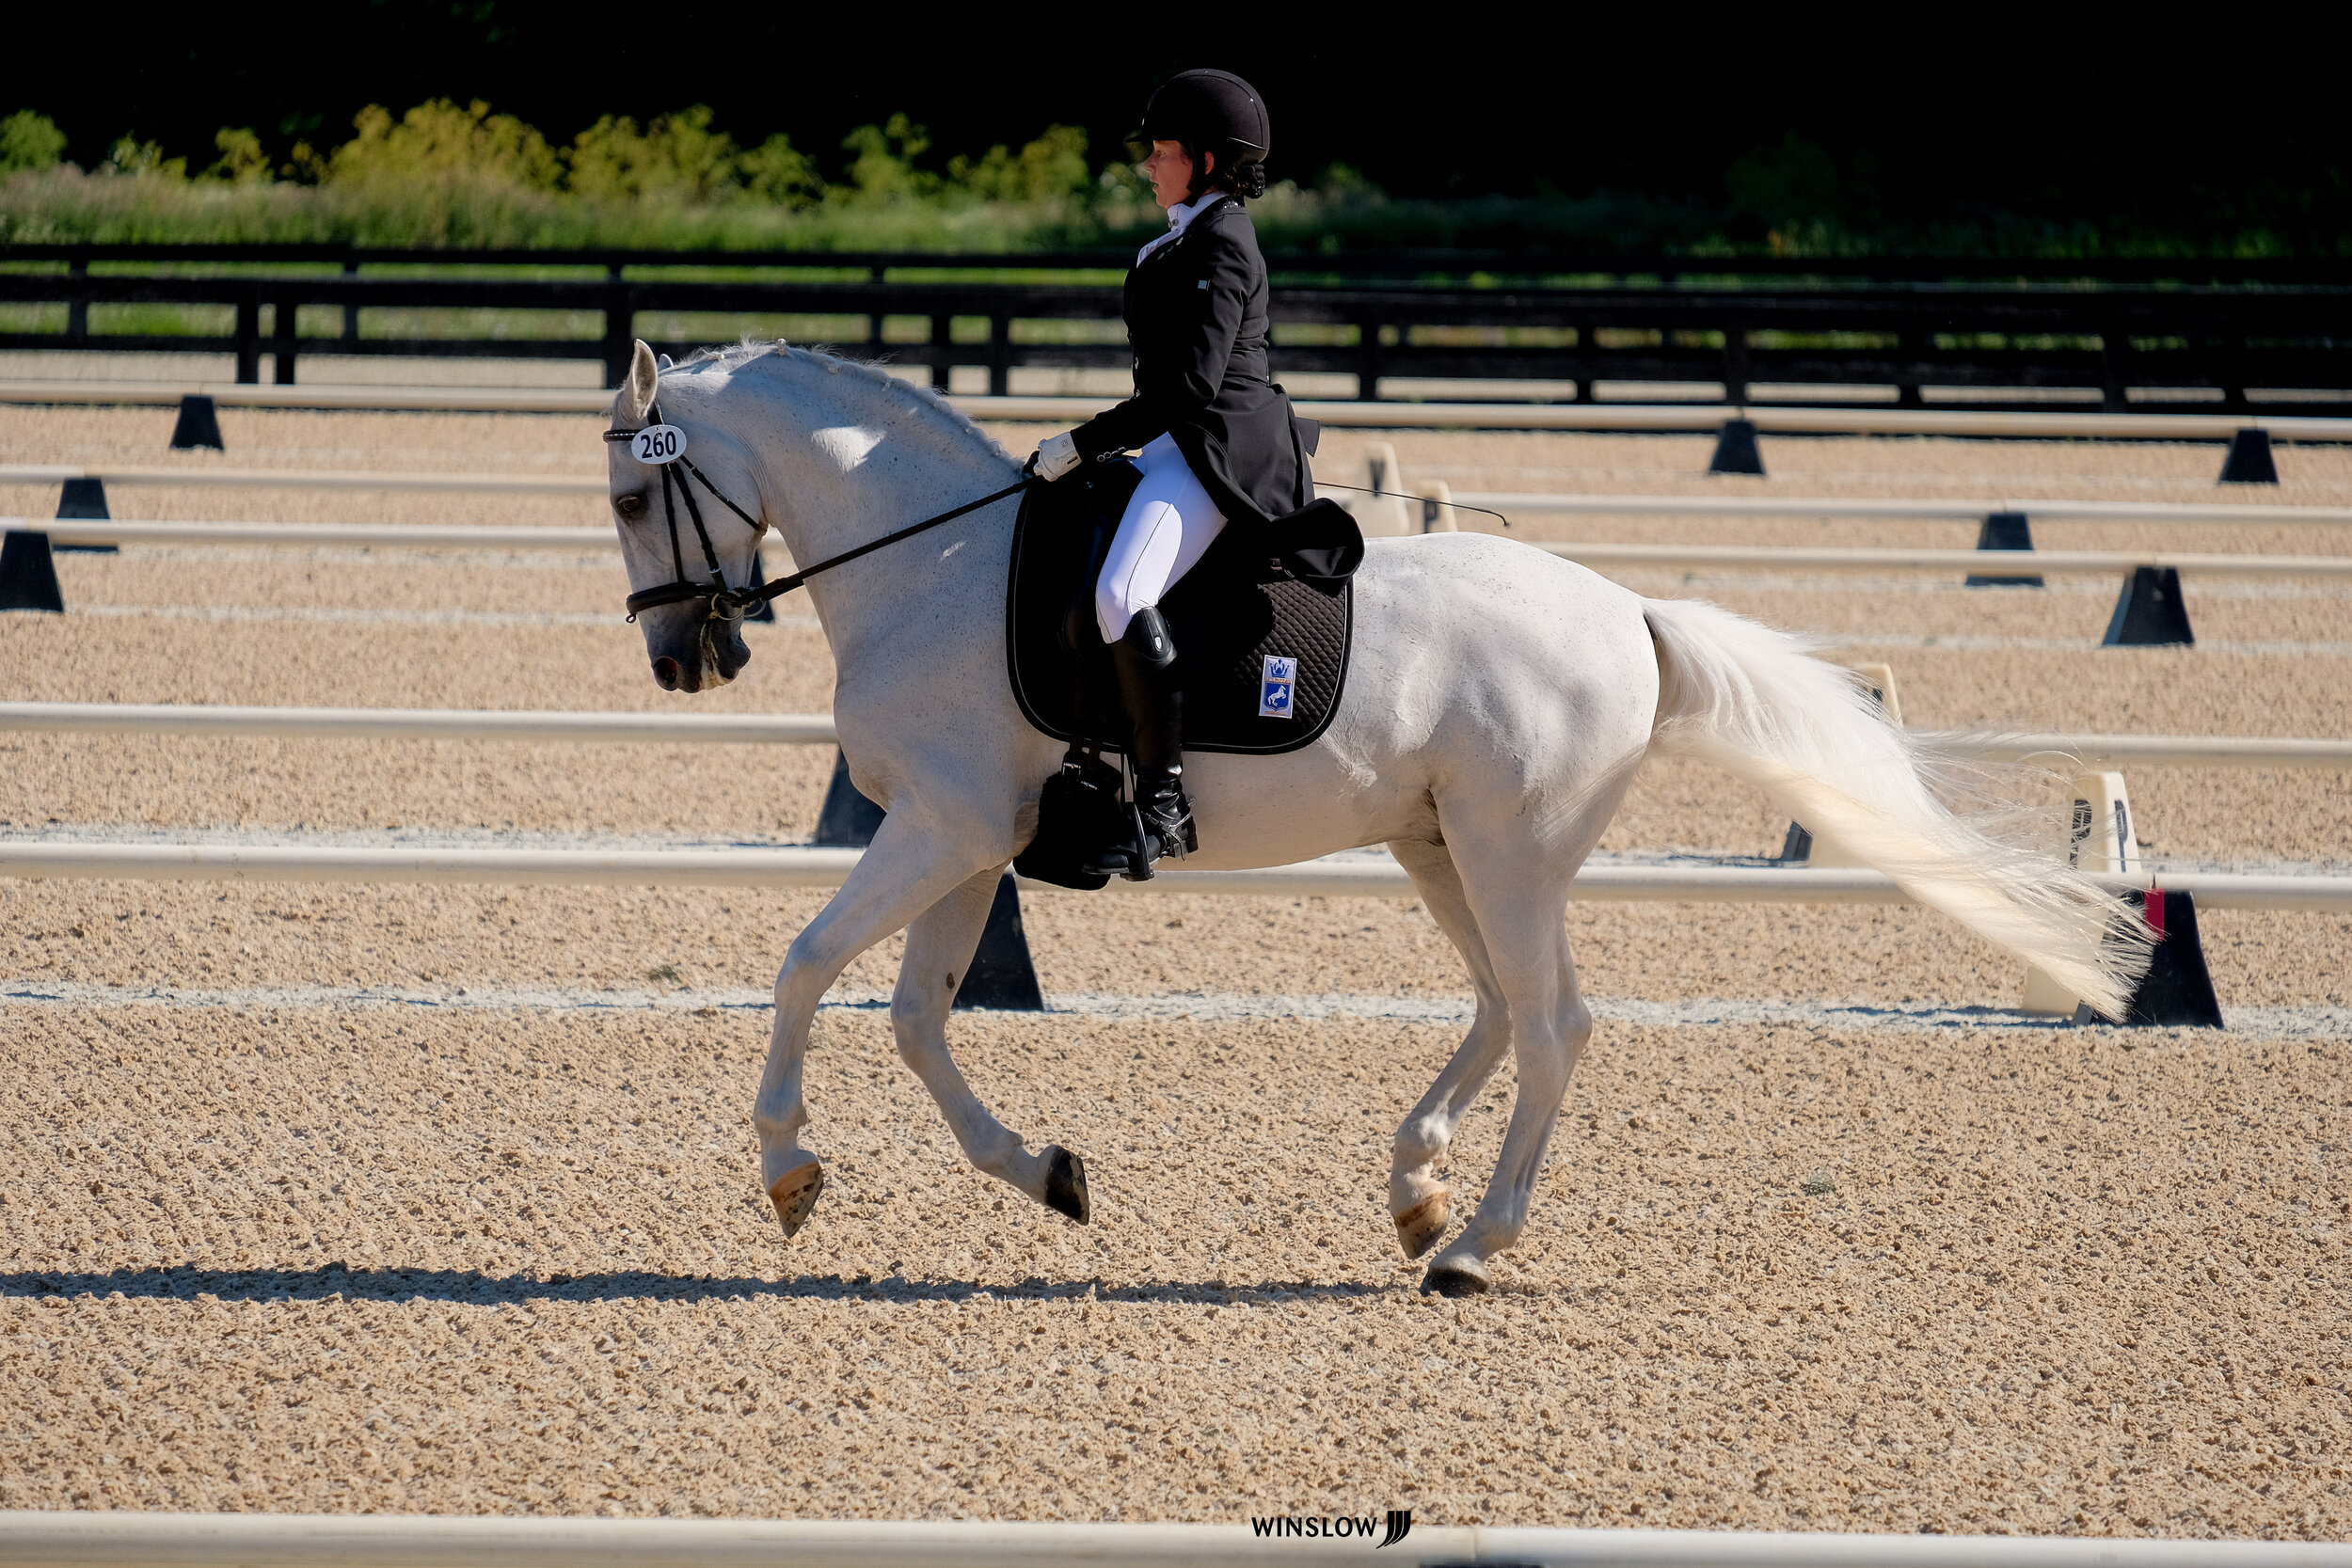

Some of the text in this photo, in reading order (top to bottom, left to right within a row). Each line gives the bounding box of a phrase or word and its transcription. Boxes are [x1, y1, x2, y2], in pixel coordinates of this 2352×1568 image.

[641, 431, 676, 459] 260
[2069, 799, 2092, 873] P
[2114, 800, 2129, 873] P
